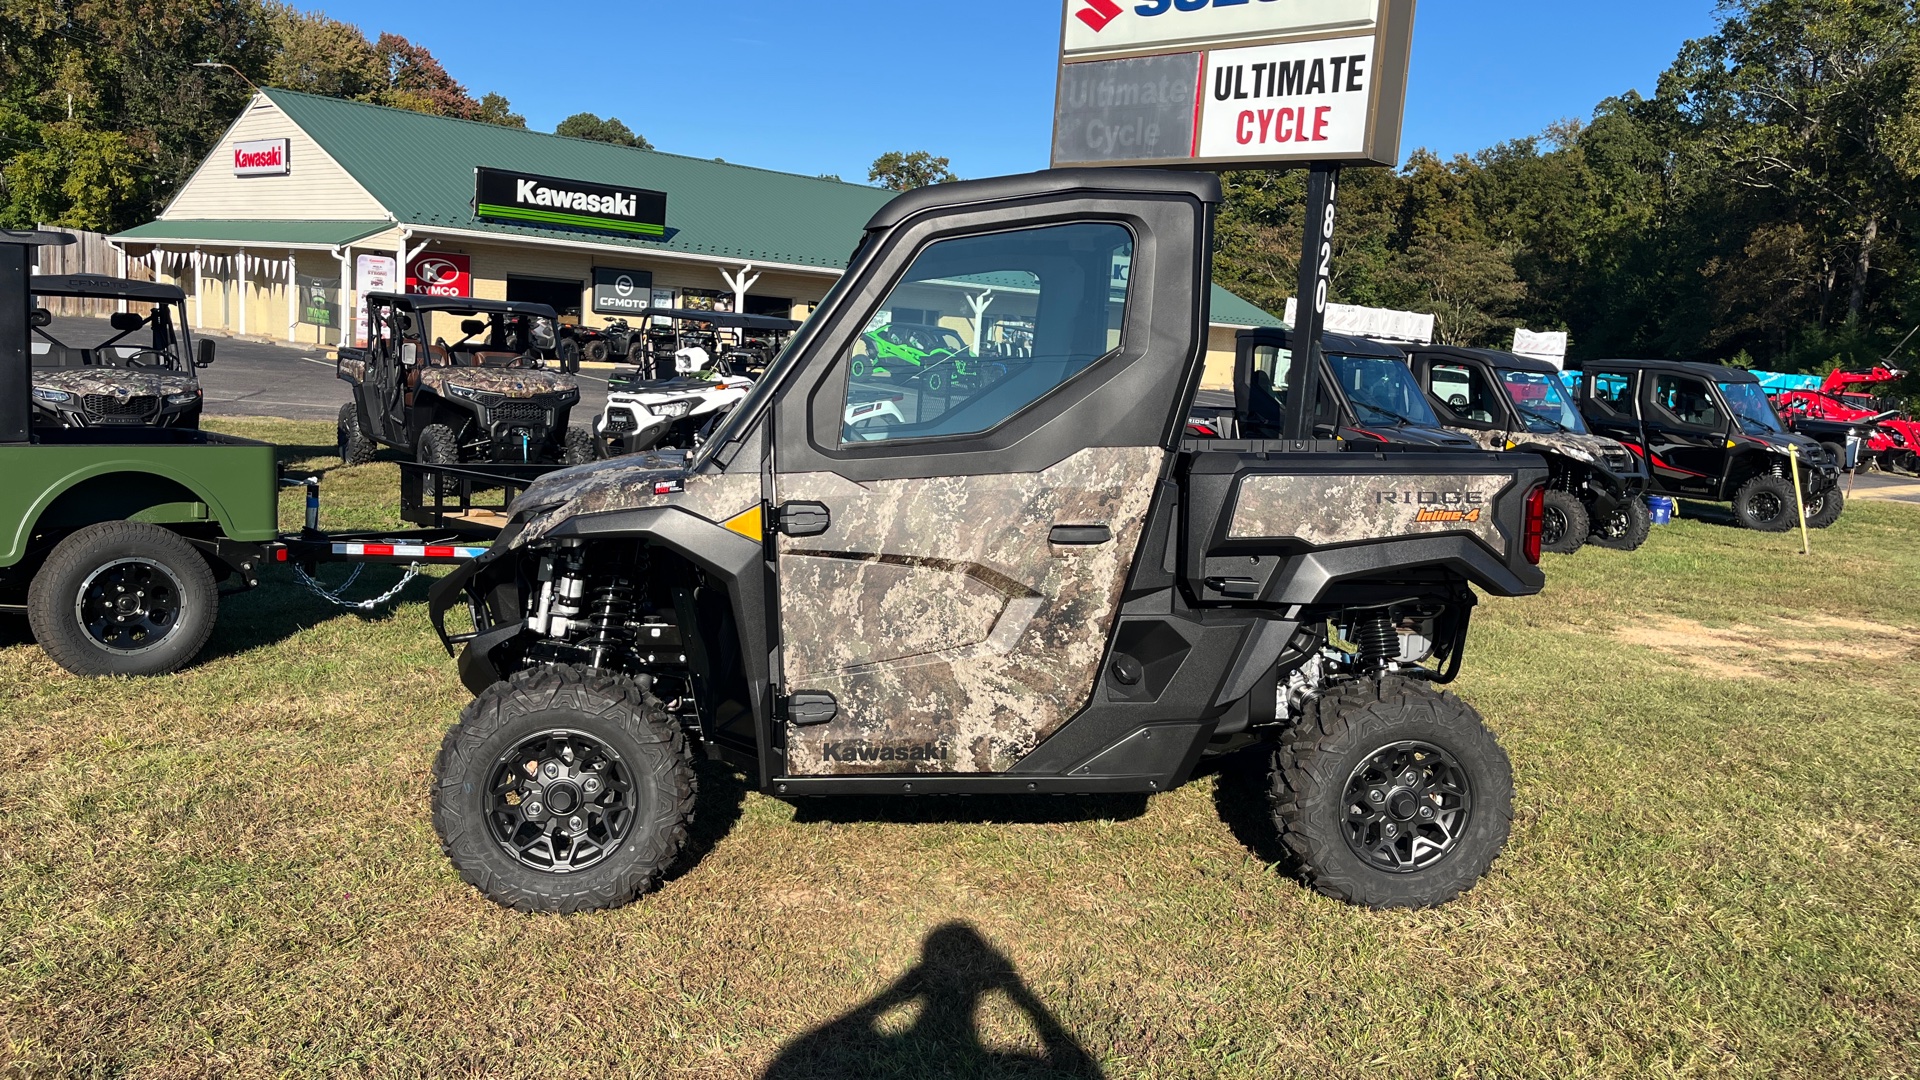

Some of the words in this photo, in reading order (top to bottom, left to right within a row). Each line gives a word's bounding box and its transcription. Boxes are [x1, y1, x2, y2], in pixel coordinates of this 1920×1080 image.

[1214, 54, 1367, 101] ULTIMATE
[1069, 76, 1188, 108] Ultimate
[1086, 117, 1161, 154] Cycle
[1236, 106, 1332, 145] CYCLE
[235, 146, 281, 168] Kawasaki
[516, 178, 637, 217] Kawasaki
[69, 279, 129, 288] CFMOTO
[413, 284, 459, 296] KYMCO
[600, 297, 647, 308] CFMOTO
[1376, 491, 1483, 504] RIDGE
[1415, 508, 1481, 522] Inline-4
[823, 742, 948, 762] Kawasaki
